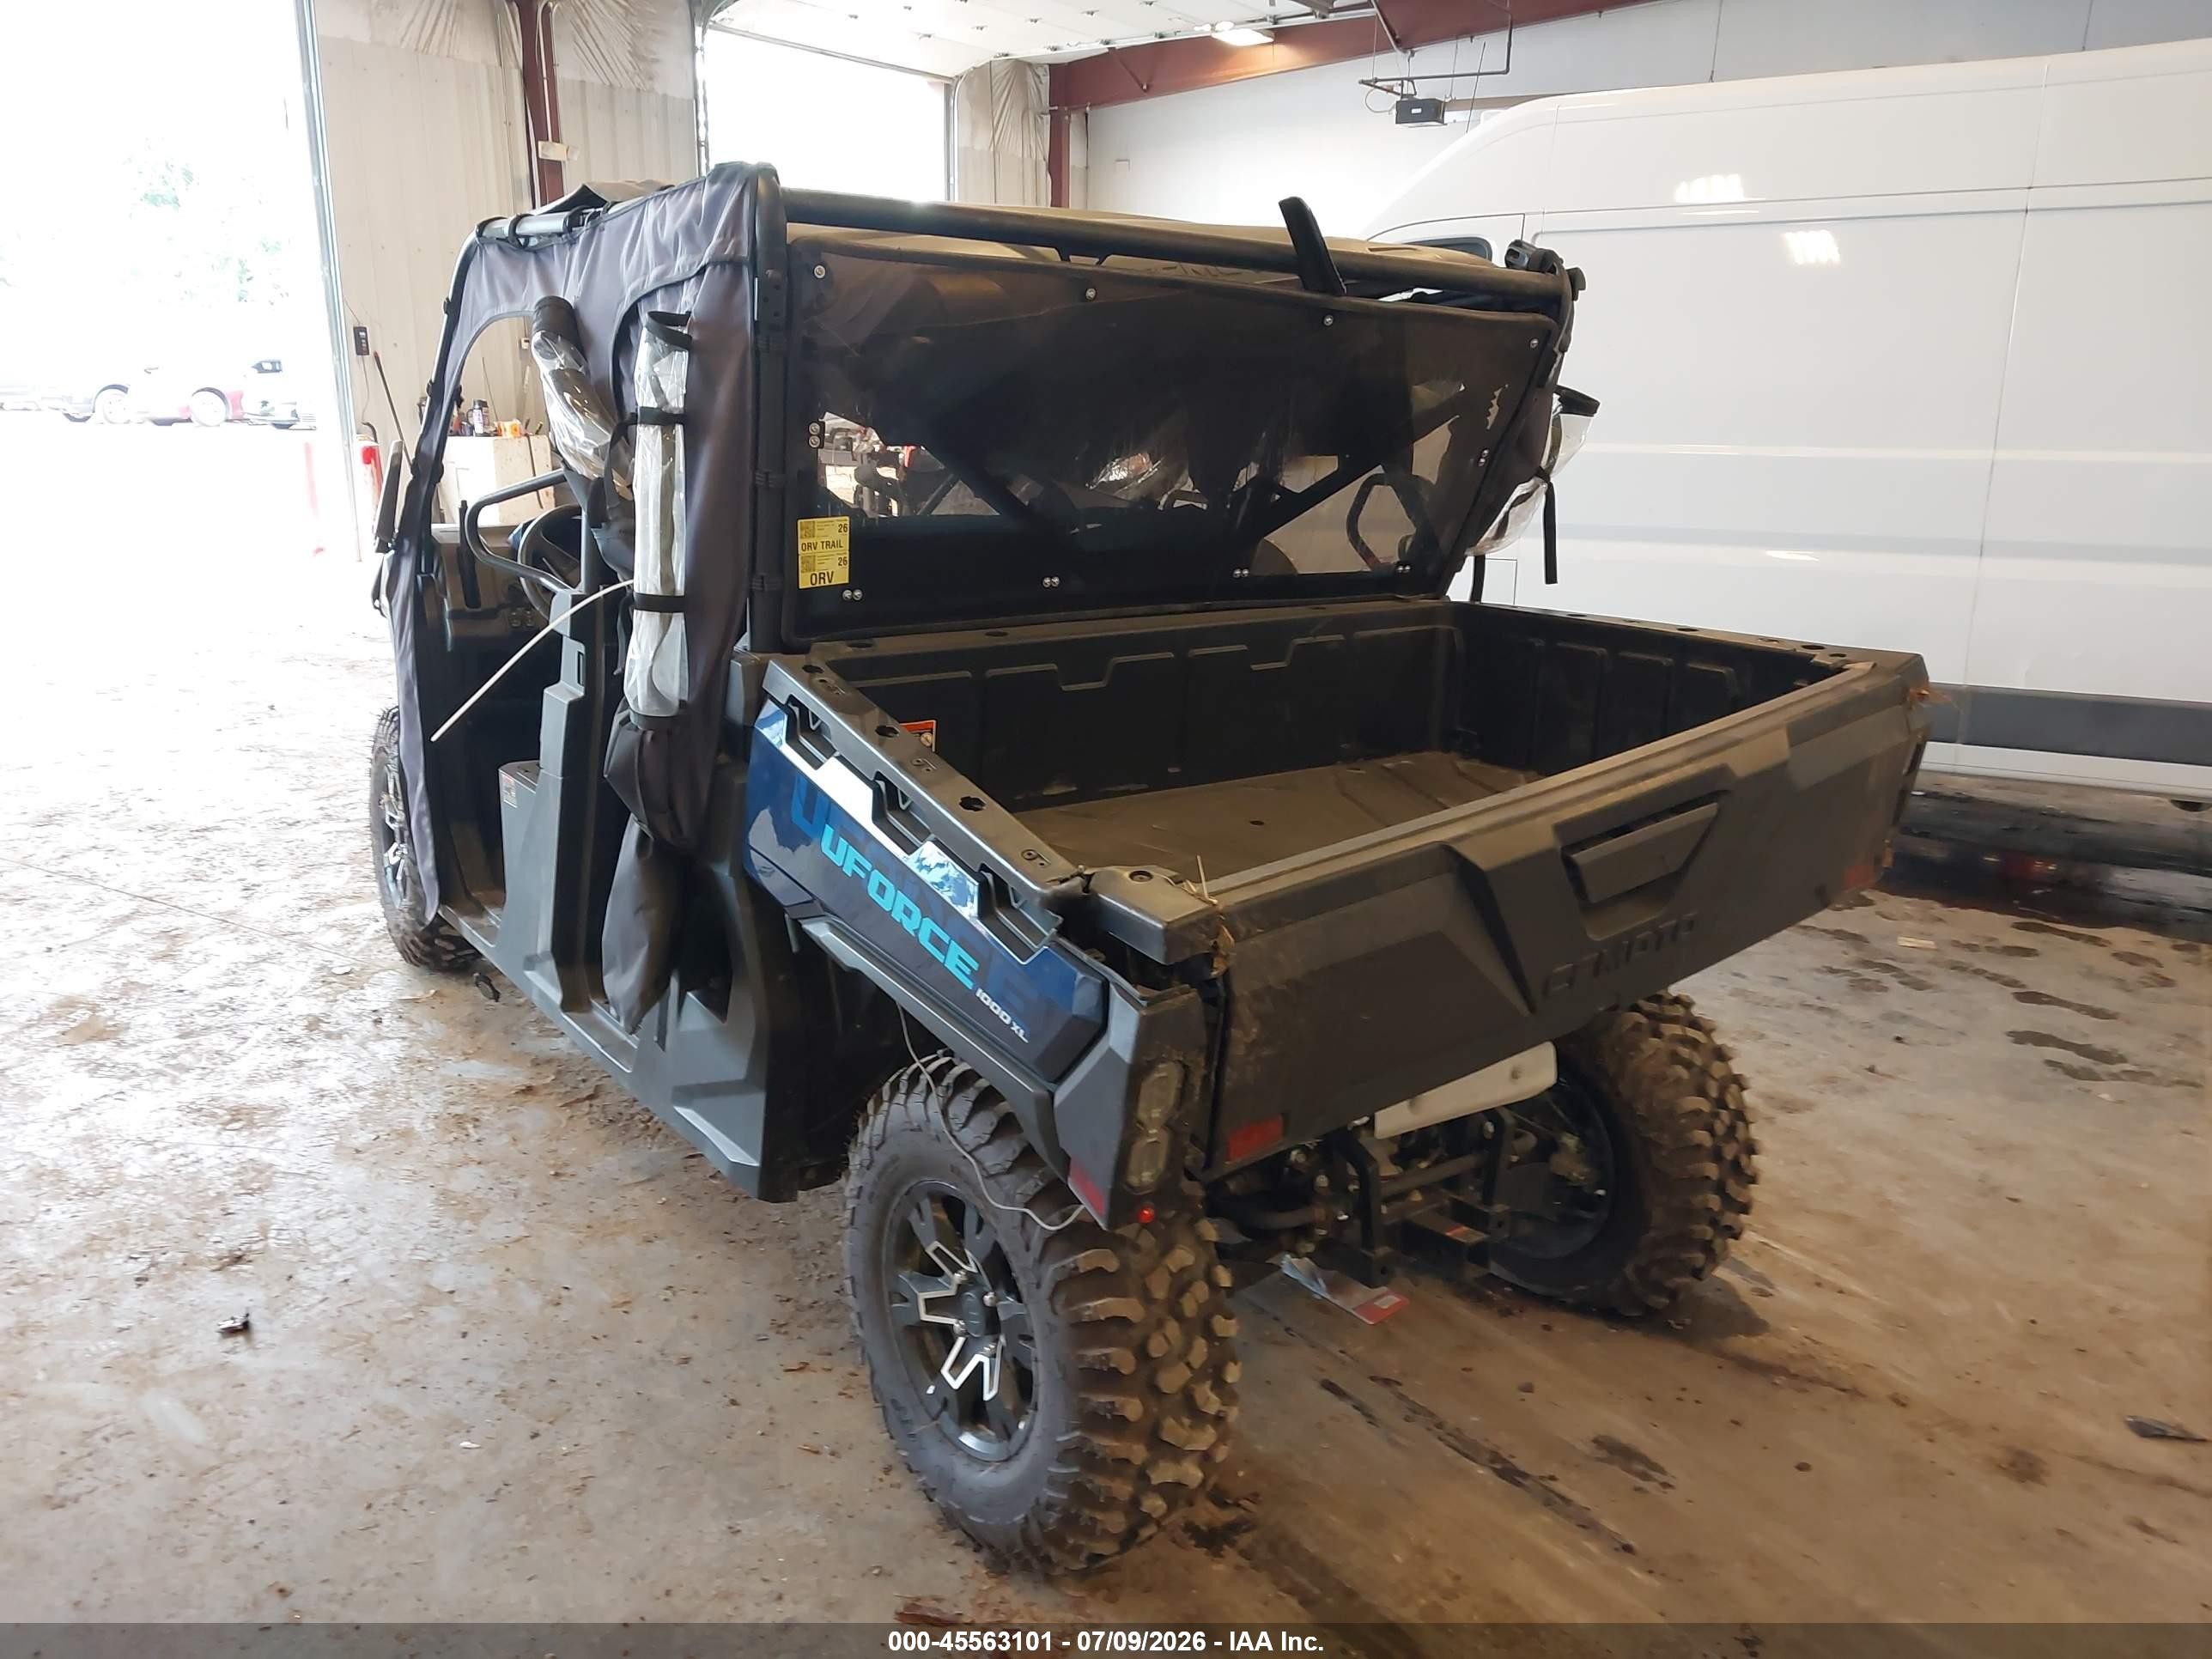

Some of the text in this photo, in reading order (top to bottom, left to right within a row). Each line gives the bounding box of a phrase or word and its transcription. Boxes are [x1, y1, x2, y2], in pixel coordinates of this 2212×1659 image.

[837, 524, 848, 532] 26
[801, 540, 843, 551] ORV TRAIL
[838, 557, 848, 566] 26
[810, 571, 834, 586] ORV
[820, 824, 979, 990] UFORCE
[975, 988, 1029, 1043] 1000 XL
